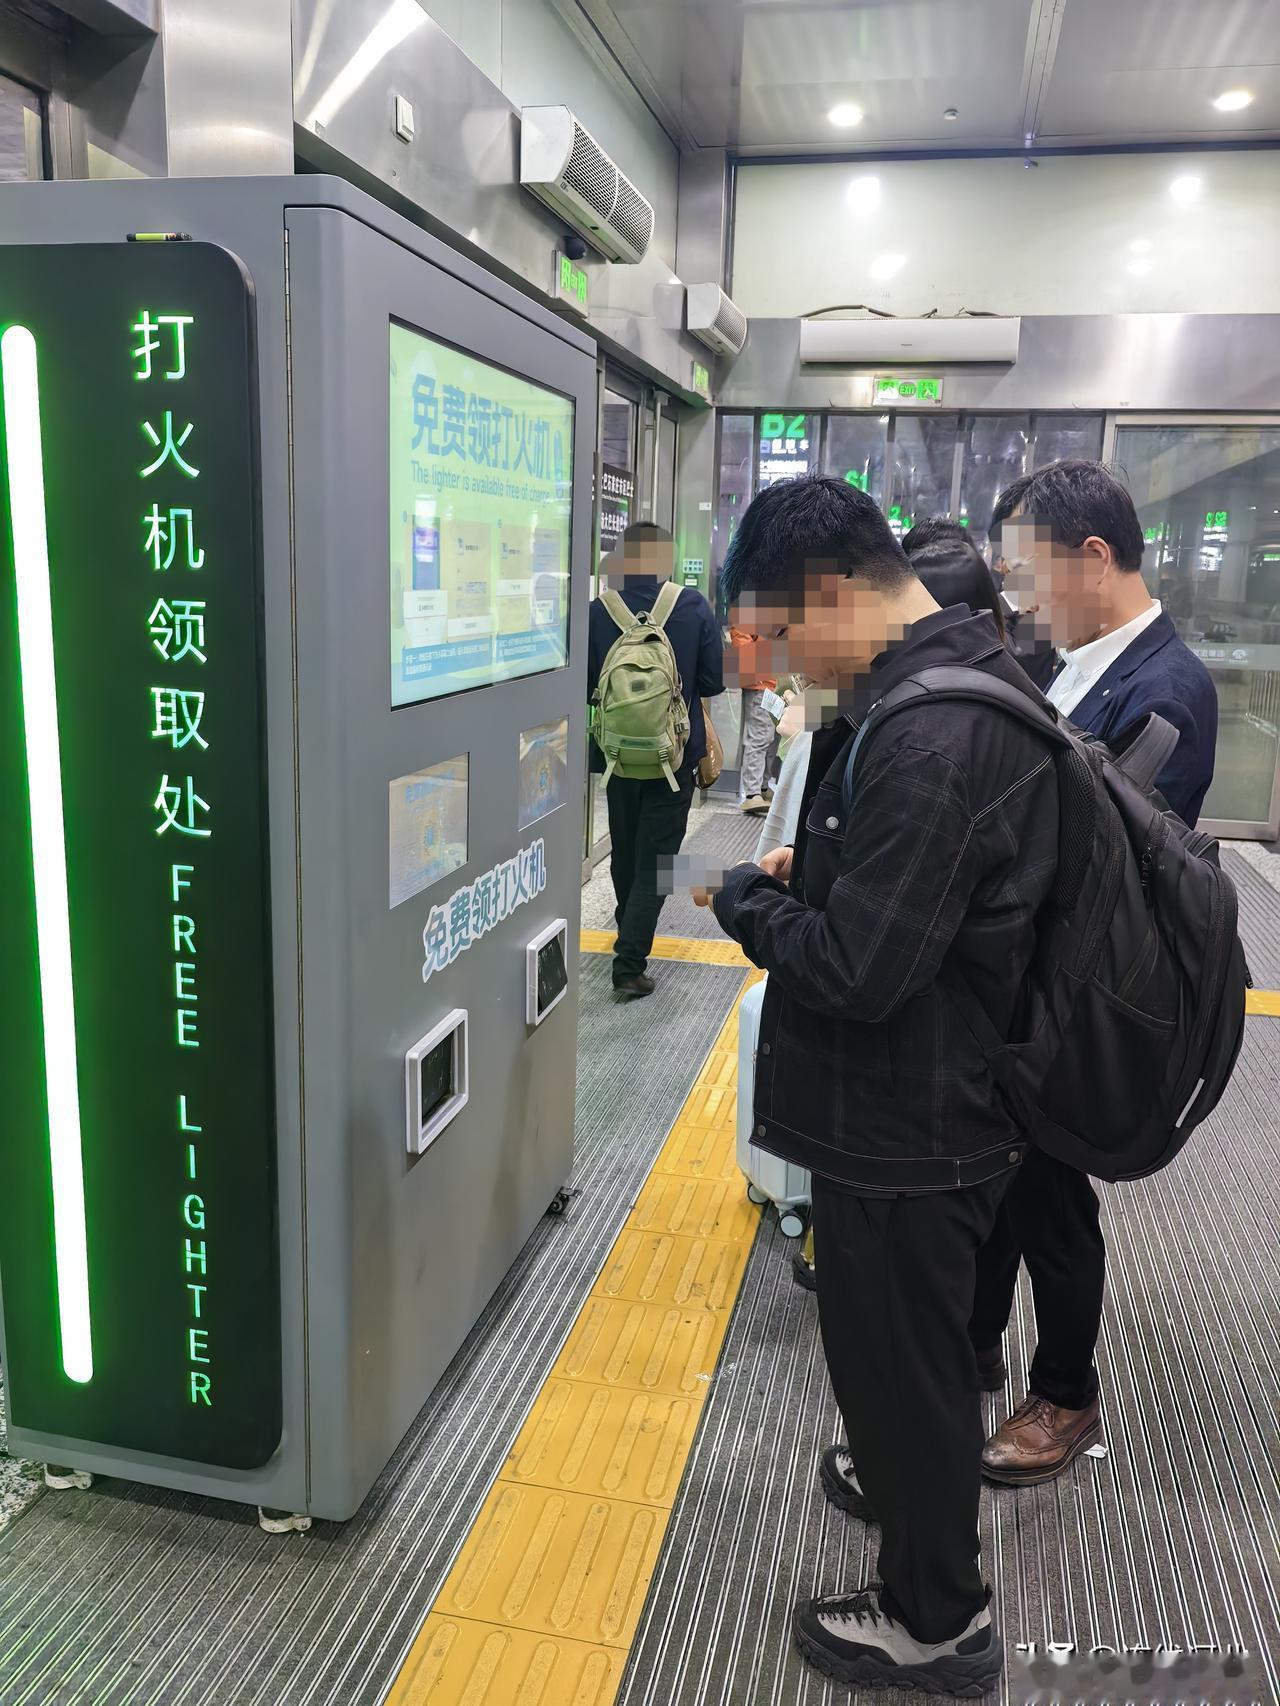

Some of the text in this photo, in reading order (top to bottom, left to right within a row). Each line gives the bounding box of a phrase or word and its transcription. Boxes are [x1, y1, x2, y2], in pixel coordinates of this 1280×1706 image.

[411, 373, 551, 480] 免费领打火机
[411, 460, 429, 484] The
[432, 464, 460, 492] lighter
[463, 470, 470, 491] is
[472, 475, 504, 496] available
[130, 310, 212, 837] 打火机领取处
[423, 840, 546, 978] 免费领打火机
[171, 864, 212, 1406] FREE LIGHTER
